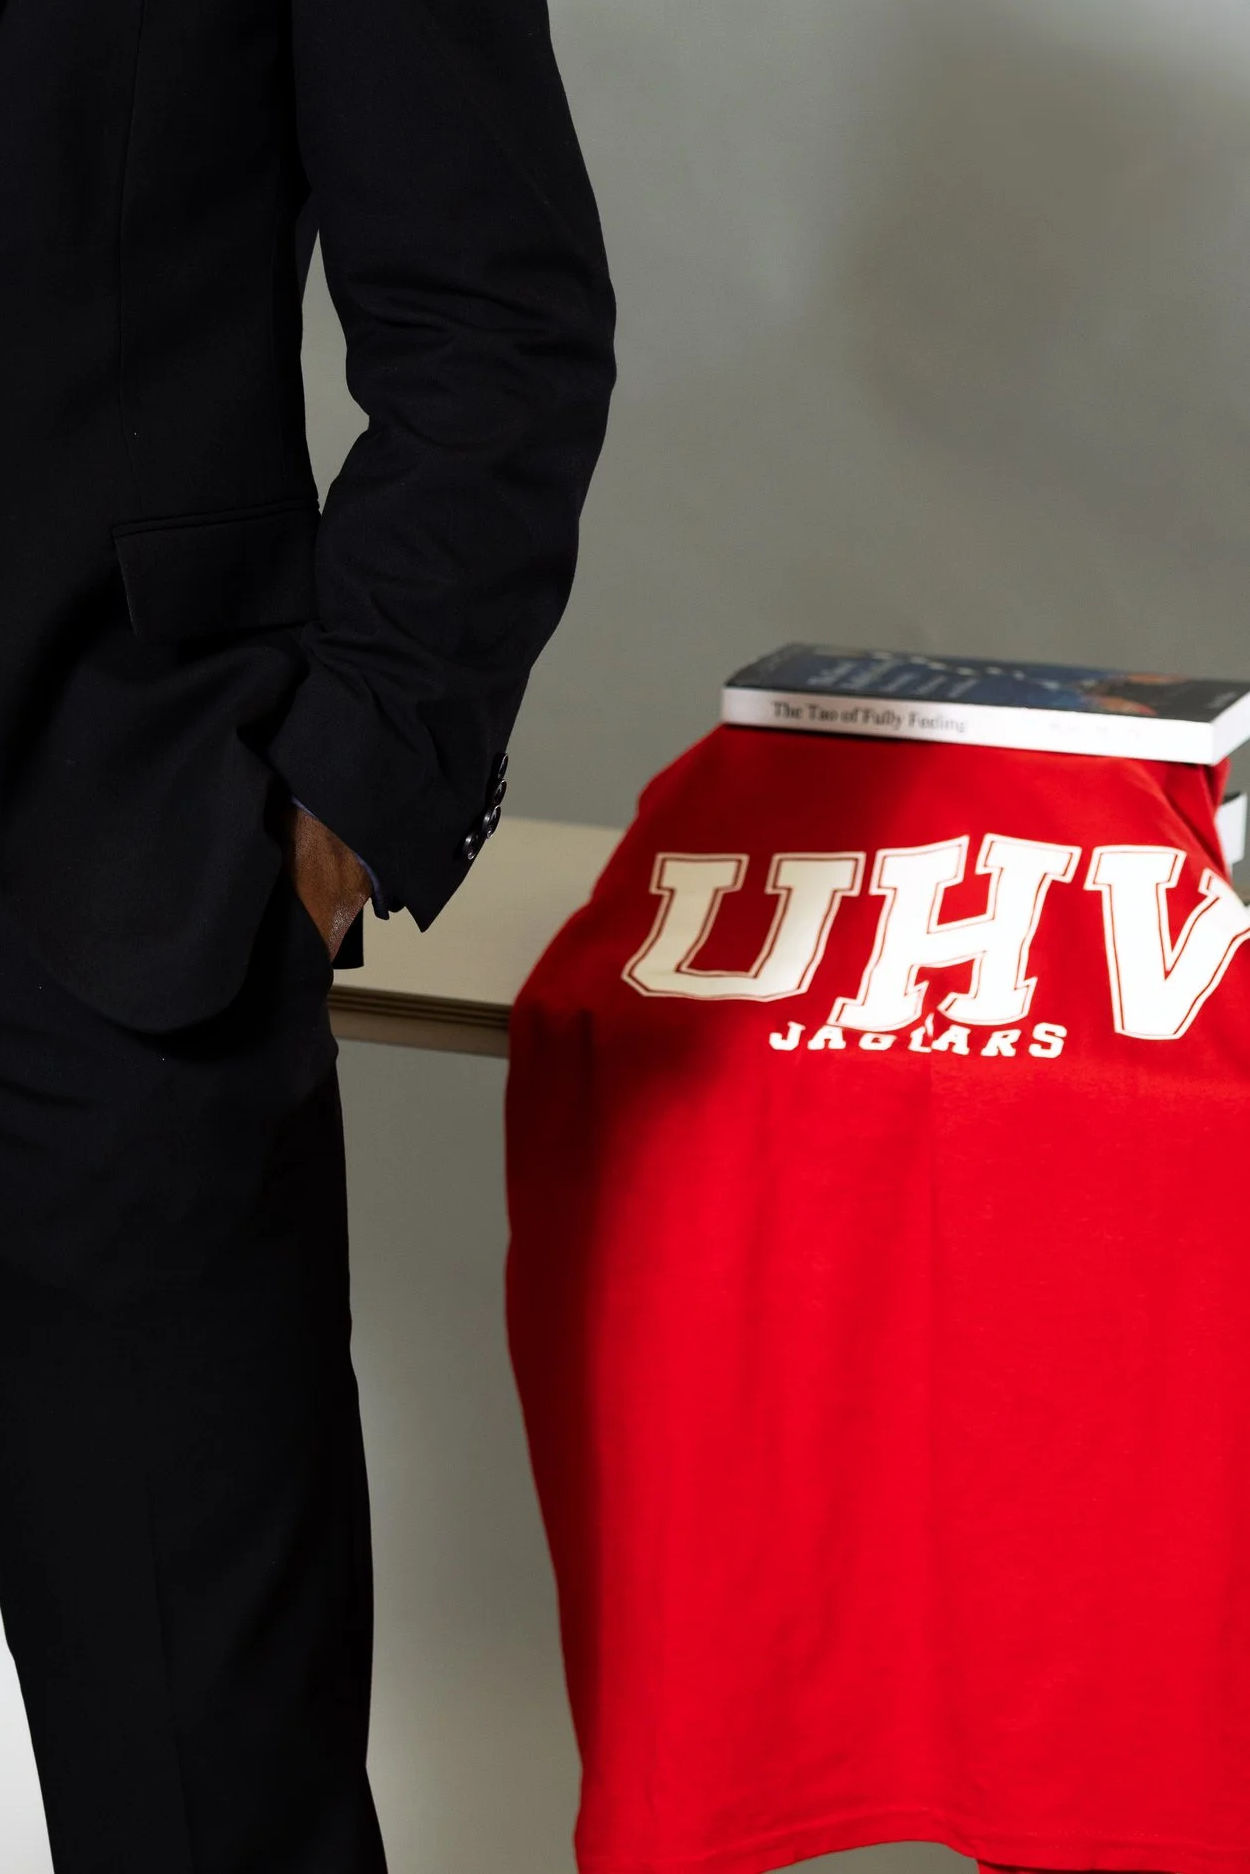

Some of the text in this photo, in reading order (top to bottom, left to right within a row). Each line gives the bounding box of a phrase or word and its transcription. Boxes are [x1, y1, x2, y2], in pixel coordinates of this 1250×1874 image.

[773, 701, 967, 733] The Tao of Fully Feeling
[621, 833, 1250, 1040] UHV
